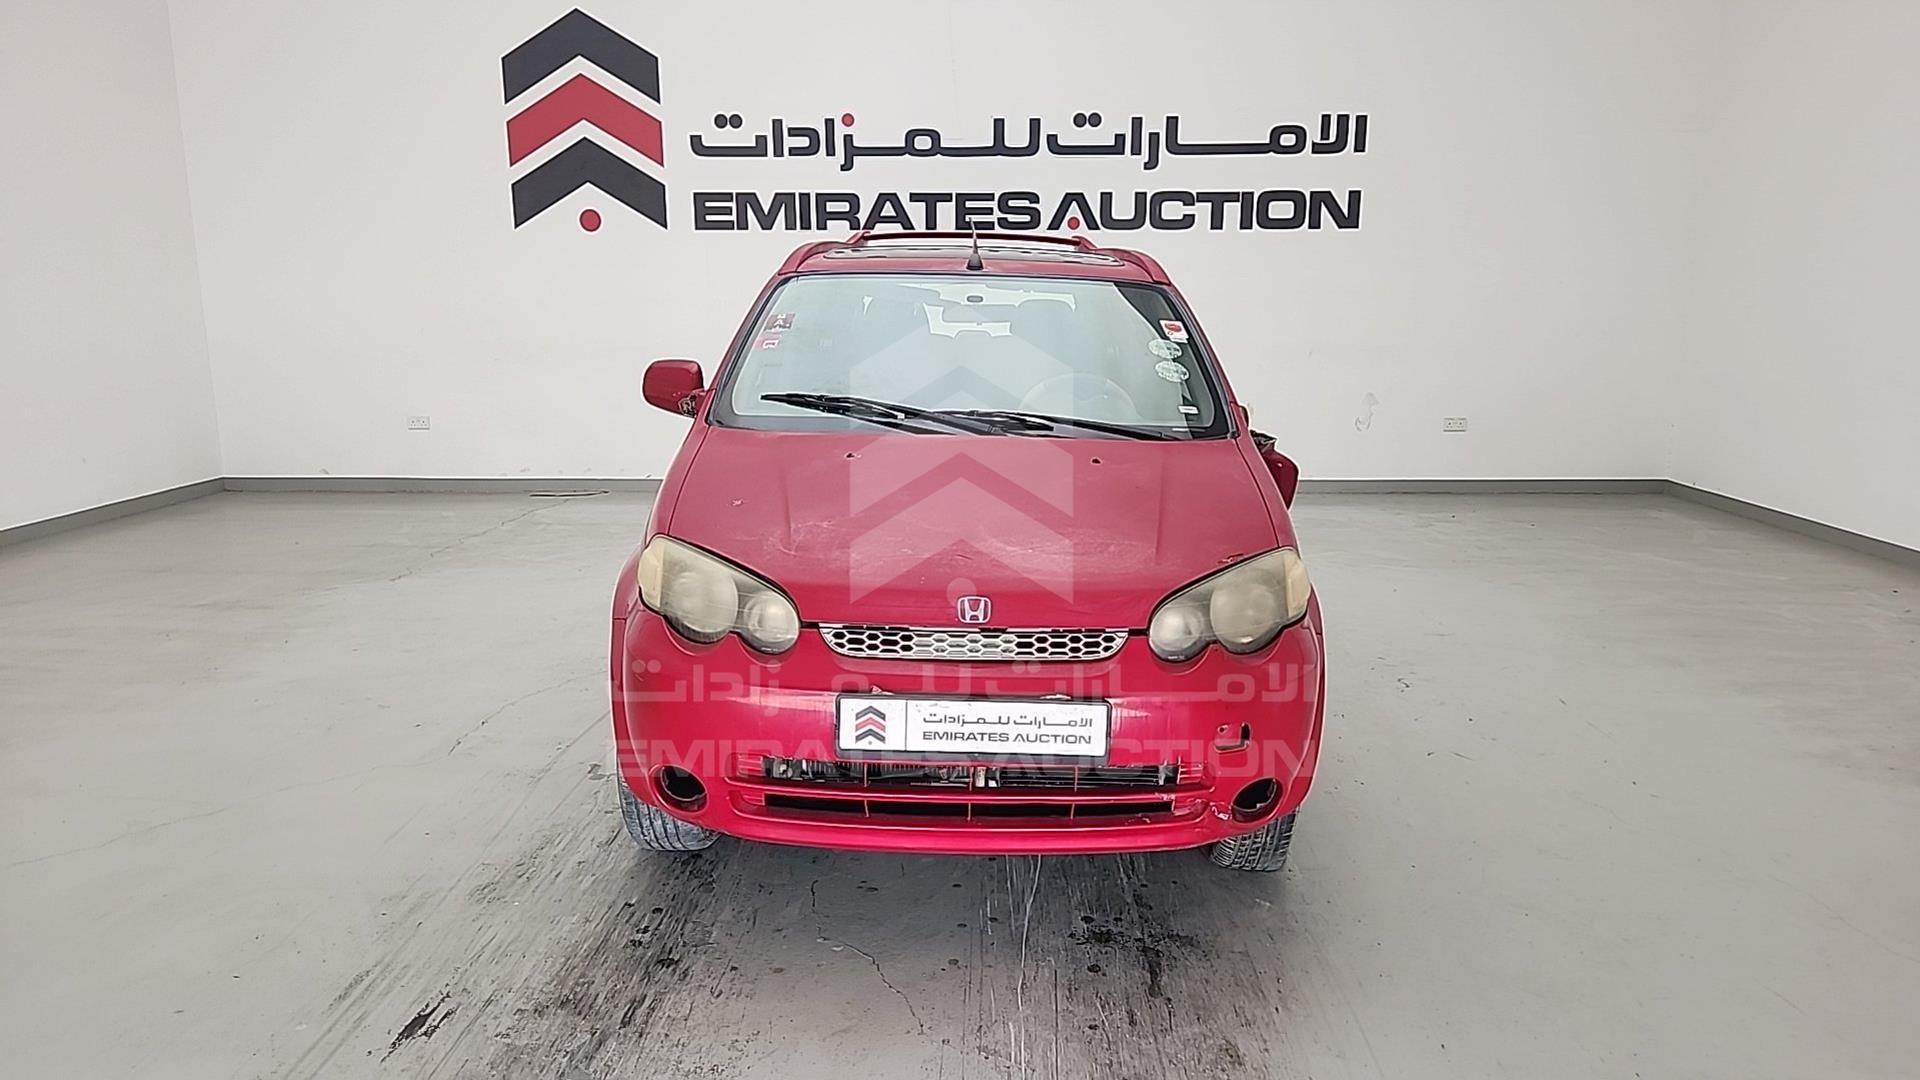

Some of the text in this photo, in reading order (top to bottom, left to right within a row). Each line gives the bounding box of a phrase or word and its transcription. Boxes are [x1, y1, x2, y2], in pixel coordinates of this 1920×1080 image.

[690, 112, 1369, 172] الامارات للمزادات
[693, 189, 1362, 231] EMIRATES AUCTION
[922, 713, 1010, 727] للمزادات
[922, 731, 1092, 744] EMIRATES AUCTION
